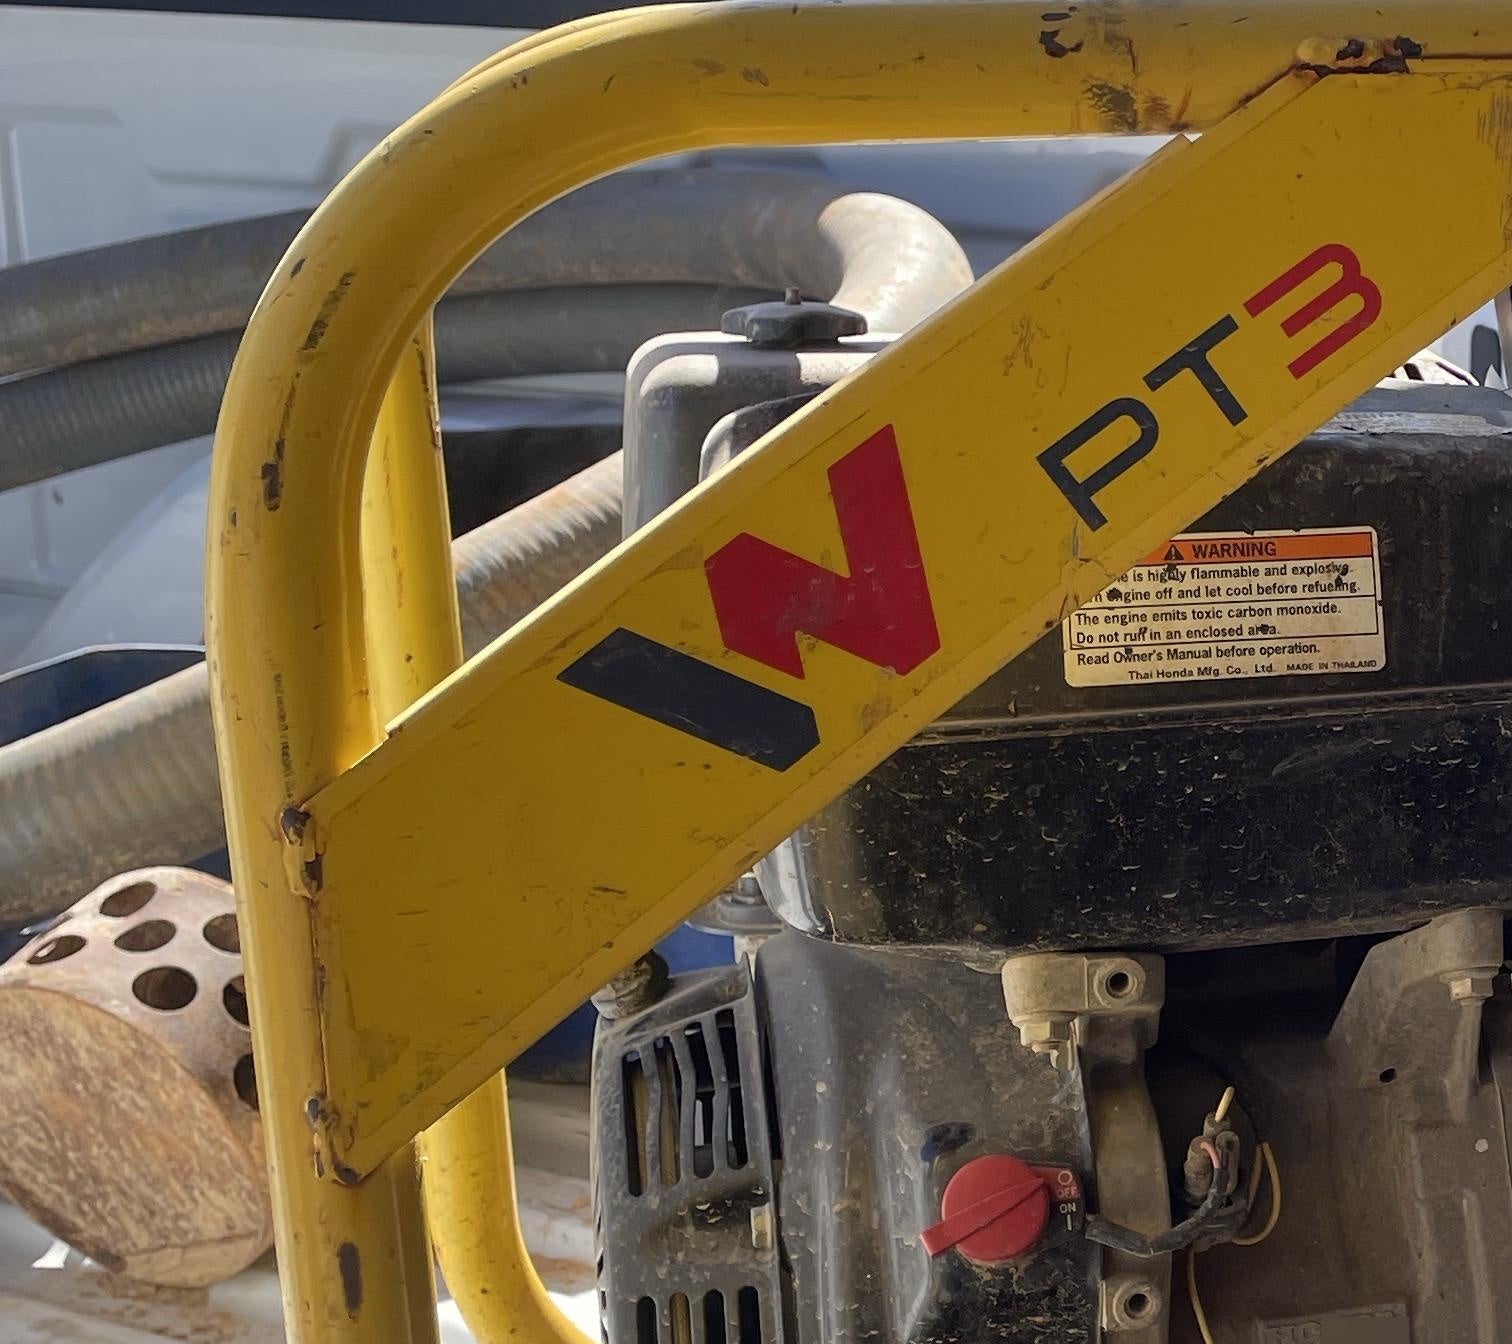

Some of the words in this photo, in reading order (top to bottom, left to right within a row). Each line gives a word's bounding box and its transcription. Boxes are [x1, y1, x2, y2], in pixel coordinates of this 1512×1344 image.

[1037, 243, 1383, 532] PT3
[1192, 540, 1277, 559] WARNING
[1132, 569, 1144, 582] is
[1190, 565, 1260, 580] flammable
[1264, 563, 1287, 577] and
[1291, 561, 1354, 578] explosive.
[1106, 589, 1150, 604] ngine
[1155, 587, 1174, 600] off
[1177, 587, 1201, 599] and
[1205, 585, 1222, 598] let
[1226, 583, 1253, 597] cool
[1256, 582, 1298, 596] before
[1075, 612, 1100, 626] The
[1104, 611, 1148, 626] engine
[1152, 609, 1188, 623] emits
[1191, 606, 1223, 621] toxic
[1227, 604, 1273, 619] carbon
[1276, 601, 1342, 617] monoxide.
[1076, 631, 1094, 645] Do
[1098, 630, 1120, 644] not
[1149, 628, 1162, 641] in
[1165, 629, 1182, 641] an
[1186, 624, 1243, 640] enclosed
[1247, 624, 1281, 637] ara.
[1077, 650, 1110, 666] Read
[1113, 648, 1163, 664] Owner's
[1166, 646, 1212, 661] Manual
[1216, 644, 1256, 658] before
[1259, 642, 1321, 658] operation.
[1128, 668, 1153, 681] Thai
[1156, 666, 1194, 679] Honda
[1286, 662, 1314, 672] MADE
[1319, 661, 1329, 670] IN
[1332, 659, 1378, 670] THAILAND
[1056, 1186, 1078, 1200] OFF
[1059, 1201, 1077, 1214] ON
